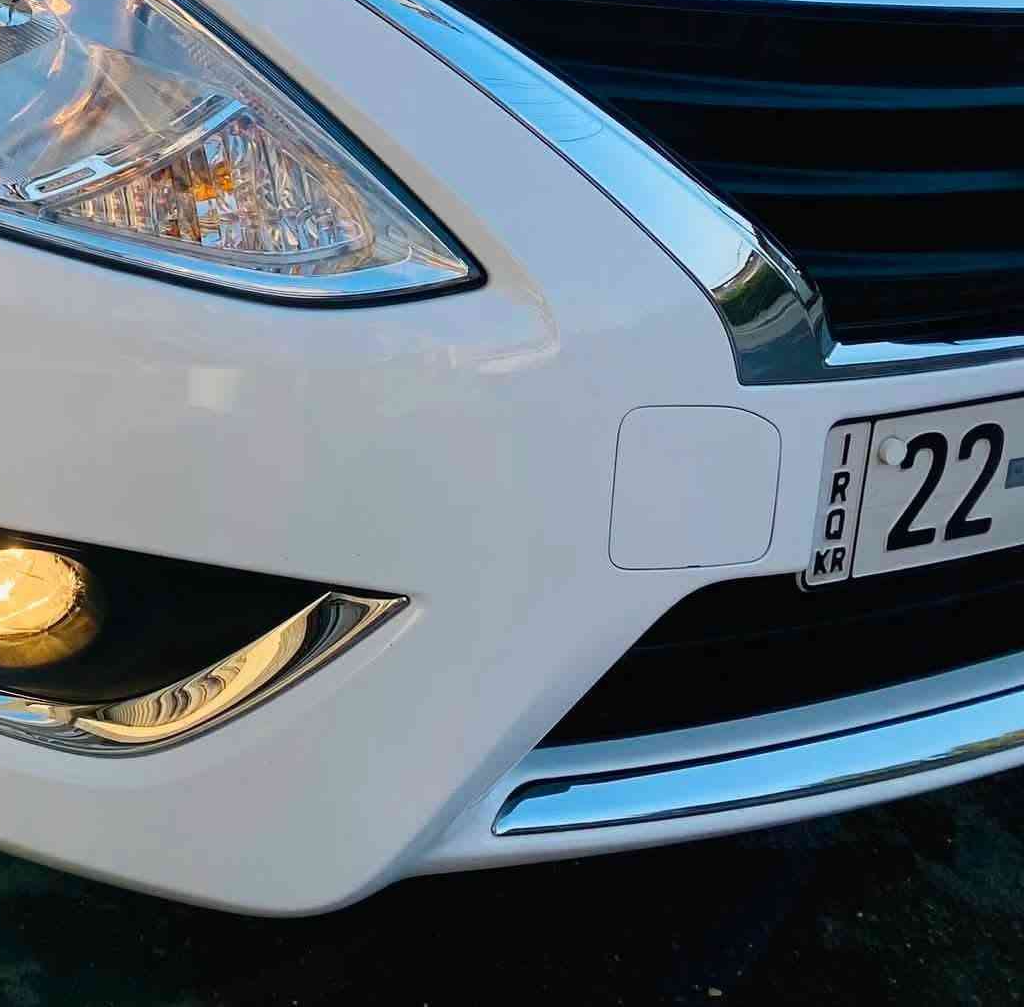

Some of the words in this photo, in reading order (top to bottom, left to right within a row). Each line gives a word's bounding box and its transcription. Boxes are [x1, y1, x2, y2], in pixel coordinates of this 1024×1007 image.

[825, 433, 851, 540] IRQ
[886, 422, 1005, 552] 22
[813, 547, 846, 576] KR
